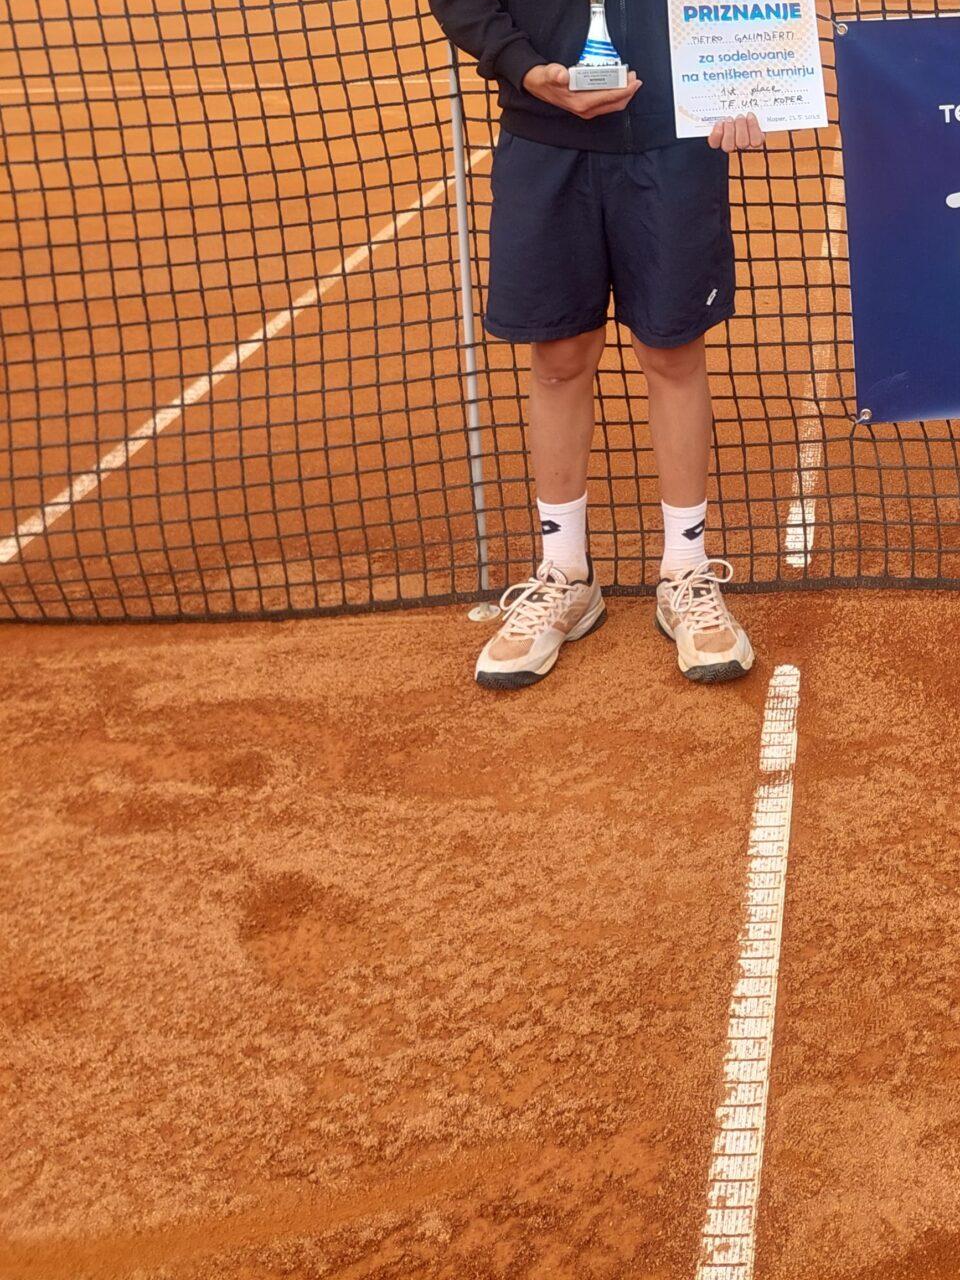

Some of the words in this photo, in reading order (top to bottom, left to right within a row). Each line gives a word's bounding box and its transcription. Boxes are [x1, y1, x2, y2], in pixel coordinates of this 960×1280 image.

[683, 2, 802, 22] PRIZNANJE
[698, 54, 714, 64] za
[718, 49, 795, 63] sodelovanje
[681, 72, 699, 83] na
[766, 64, 815, 78] turnirju
[773, 95, 804, 106] KOPER
